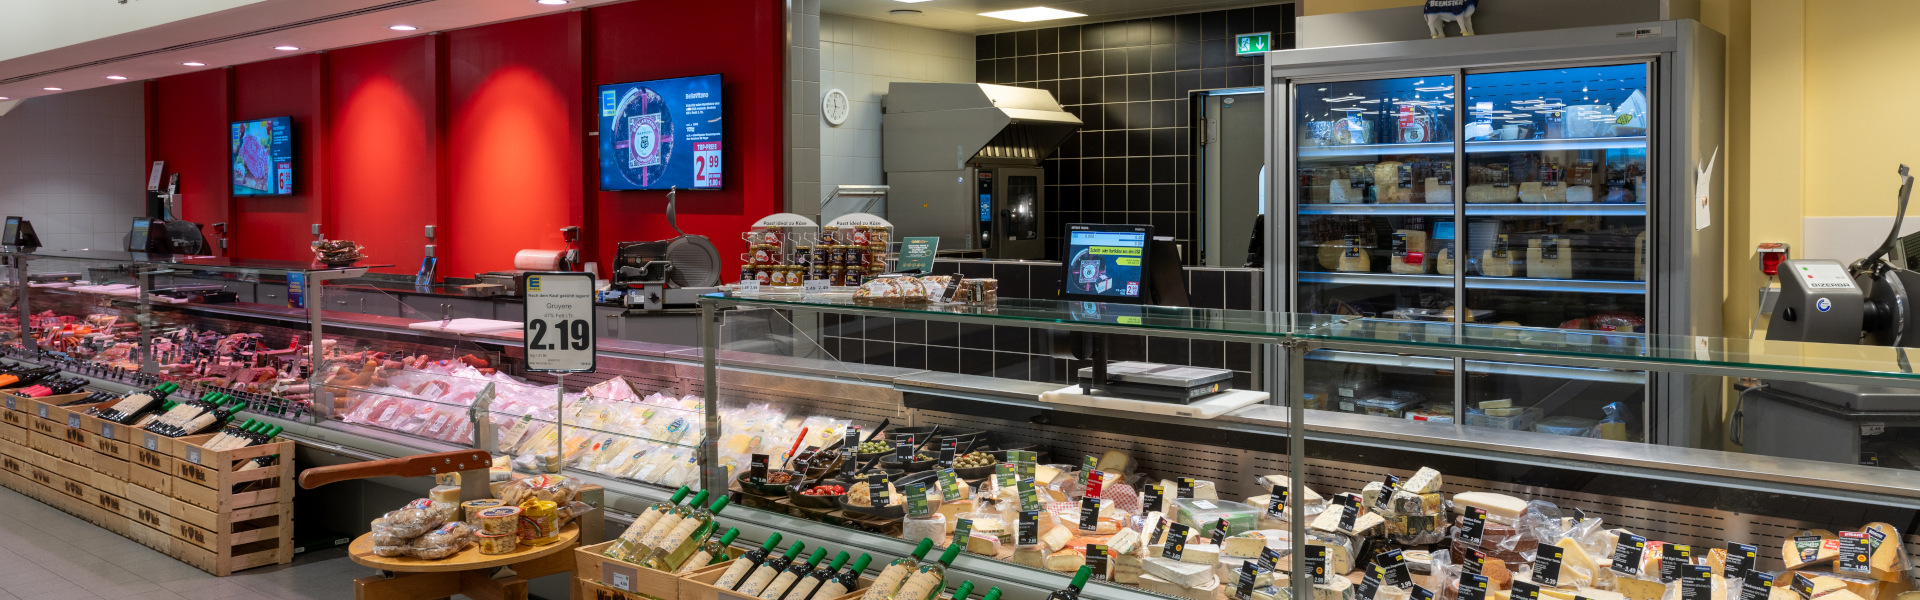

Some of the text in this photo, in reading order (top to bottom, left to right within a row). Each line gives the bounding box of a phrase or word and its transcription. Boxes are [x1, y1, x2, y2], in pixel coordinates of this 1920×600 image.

[696, 155, 719, 181] 2 99
[279, 172, 284, 190] 6
[529, 277, 540, 288] E
[529, 318, 590, 351] 2.19
[1400, 581, 1412, 589] 3.99
